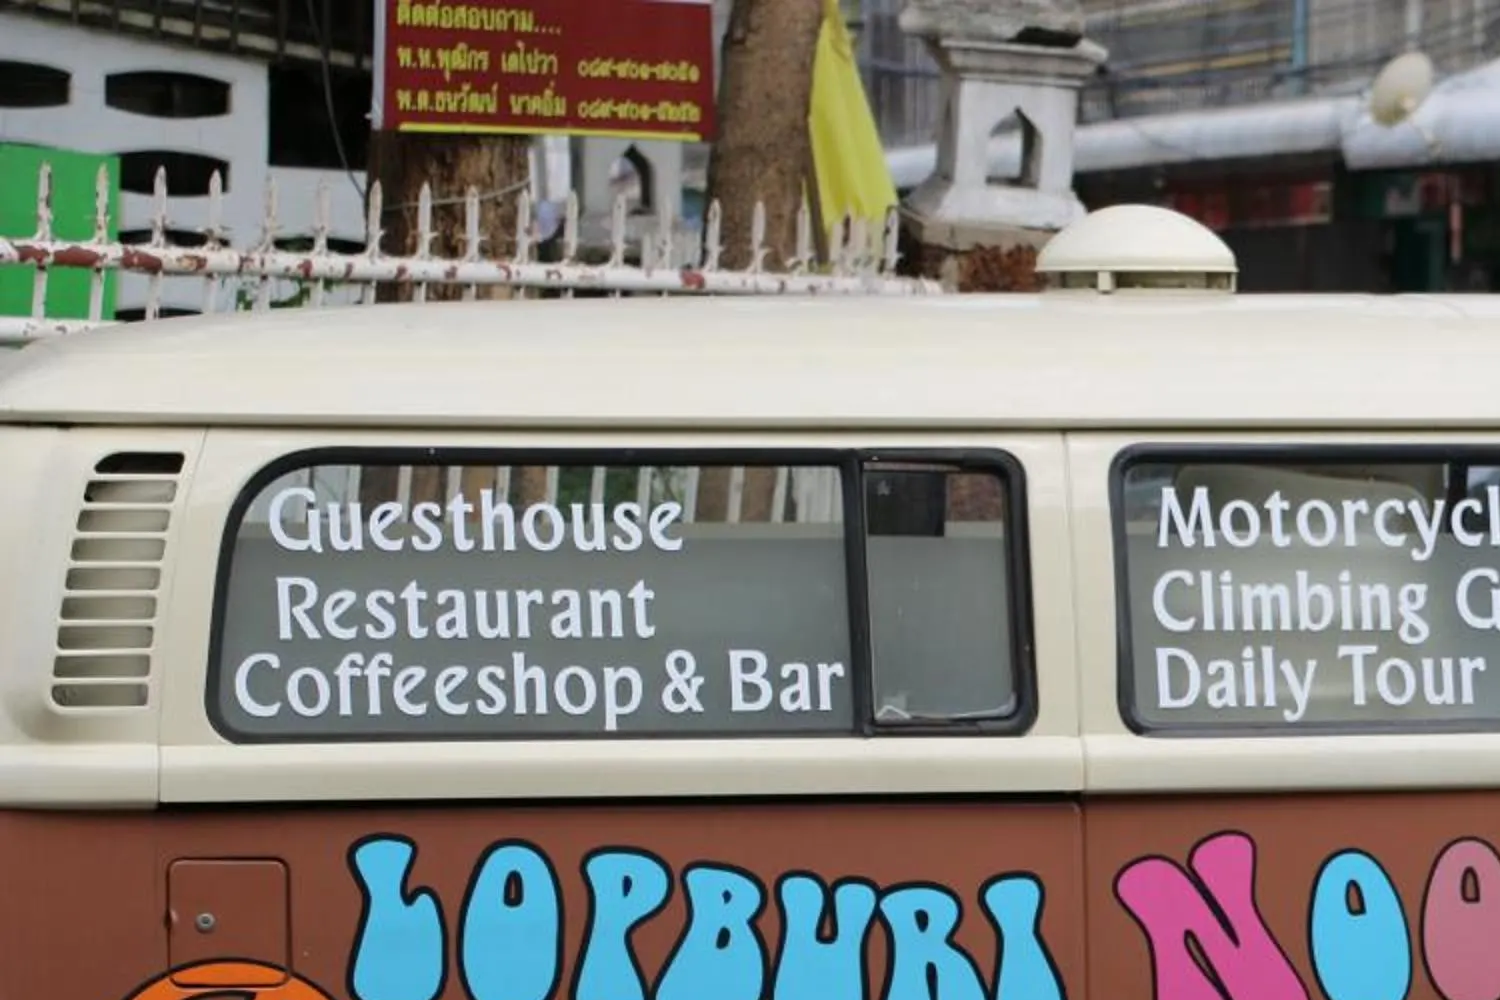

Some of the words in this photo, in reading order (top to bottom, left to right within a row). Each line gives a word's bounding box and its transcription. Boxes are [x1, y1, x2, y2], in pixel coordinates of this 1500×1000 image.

[268, 487, 684, 552] Guesthouse
[275, 576, 656, 641] Restaurant
[1152, 568, 1429, 645] Climbing
[234, 651, 644, 731] Coffeeshop
[661, 649, 704, 714] &
[729, 648, 845, 713] Bar
[1155, 645, 1316, 722] Daily
[1338, 645, 1486, 706] Tour
